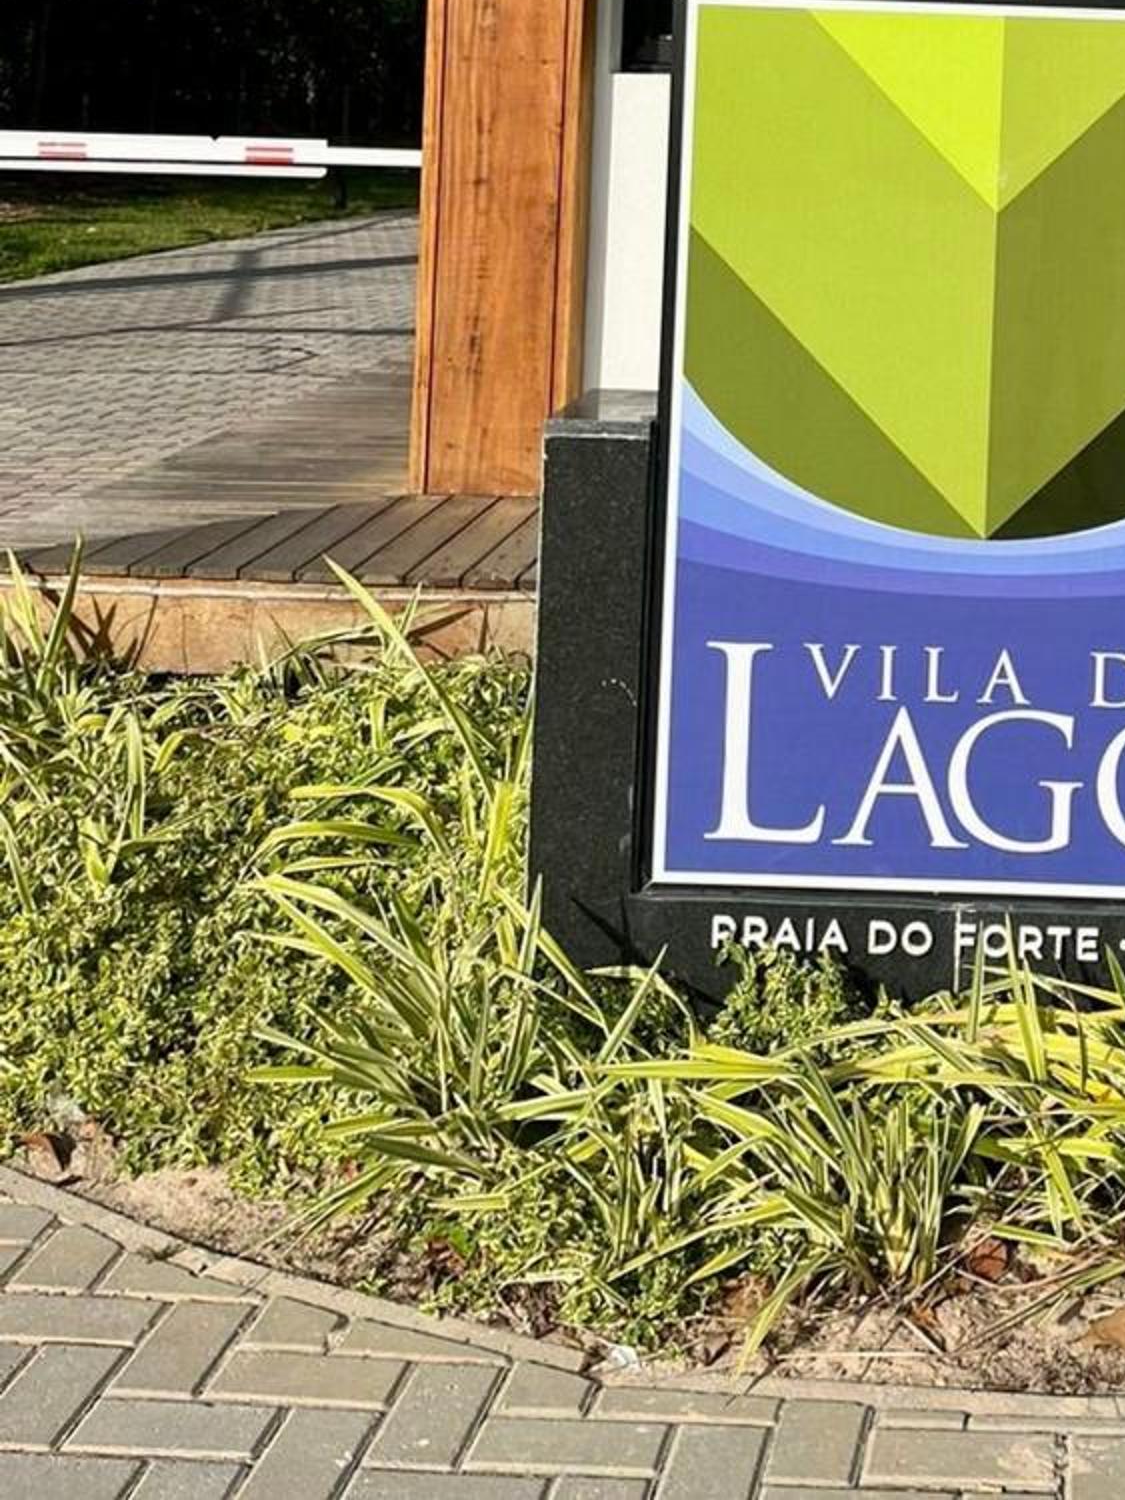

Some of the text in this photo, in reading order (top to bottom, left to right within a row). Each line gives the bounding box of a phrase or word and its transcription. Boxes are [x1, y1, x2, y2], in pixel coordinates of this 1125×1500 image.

[803, 642, 1031, 706] VILA
[710, 913, 849, 953] PRAIA
[867, 919, 934, 957] DO
[954, 922, 1099, 962] FORTE
